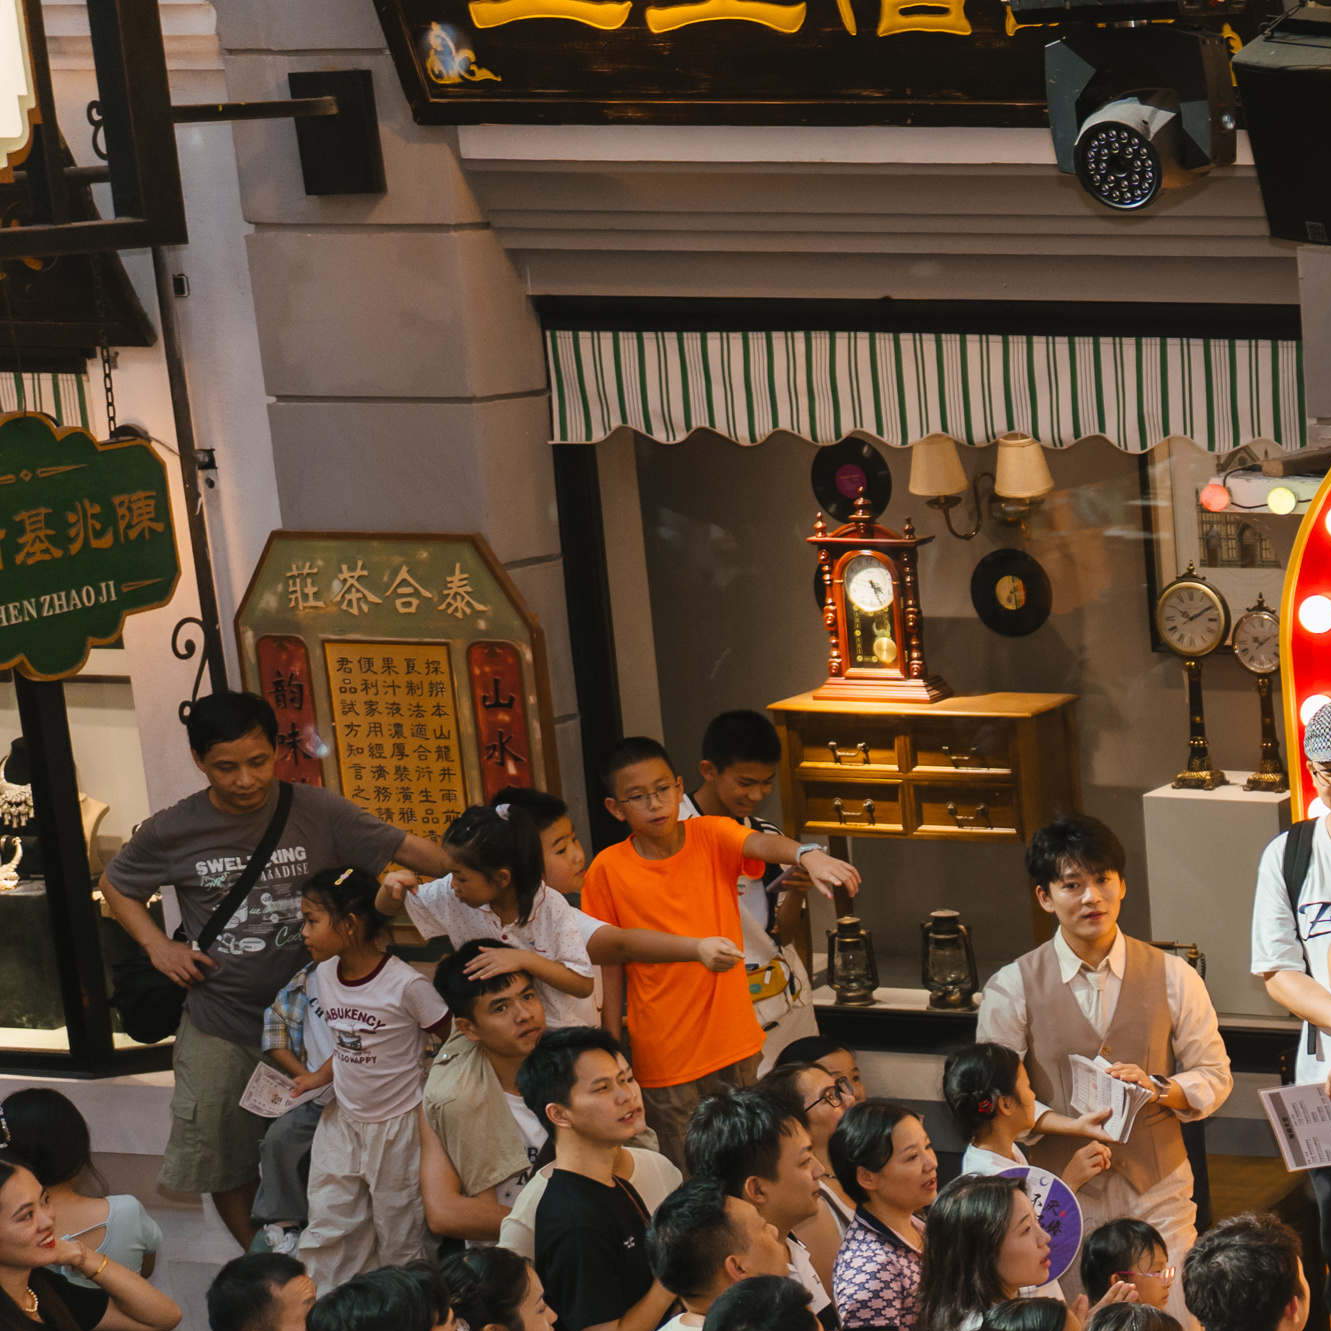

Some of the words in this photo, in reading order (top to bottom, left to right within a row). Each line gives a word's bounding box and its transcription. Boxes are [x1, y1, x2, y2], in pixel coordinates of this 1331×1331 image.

[42, 586, 95, 617] ZHAO
[100, 580, 117, 602] JI
[268, 669, 315, 783] 韵味
[336, 656, 371, 810] 君品試方知言之
[381, 657, 417, 836] 果汁液濃厚裝潢雅
[482, 676, 527, 788] 山水
[195, 846, 307, 876] SWELRING
[260, 862, 310, 881] ARADISE
